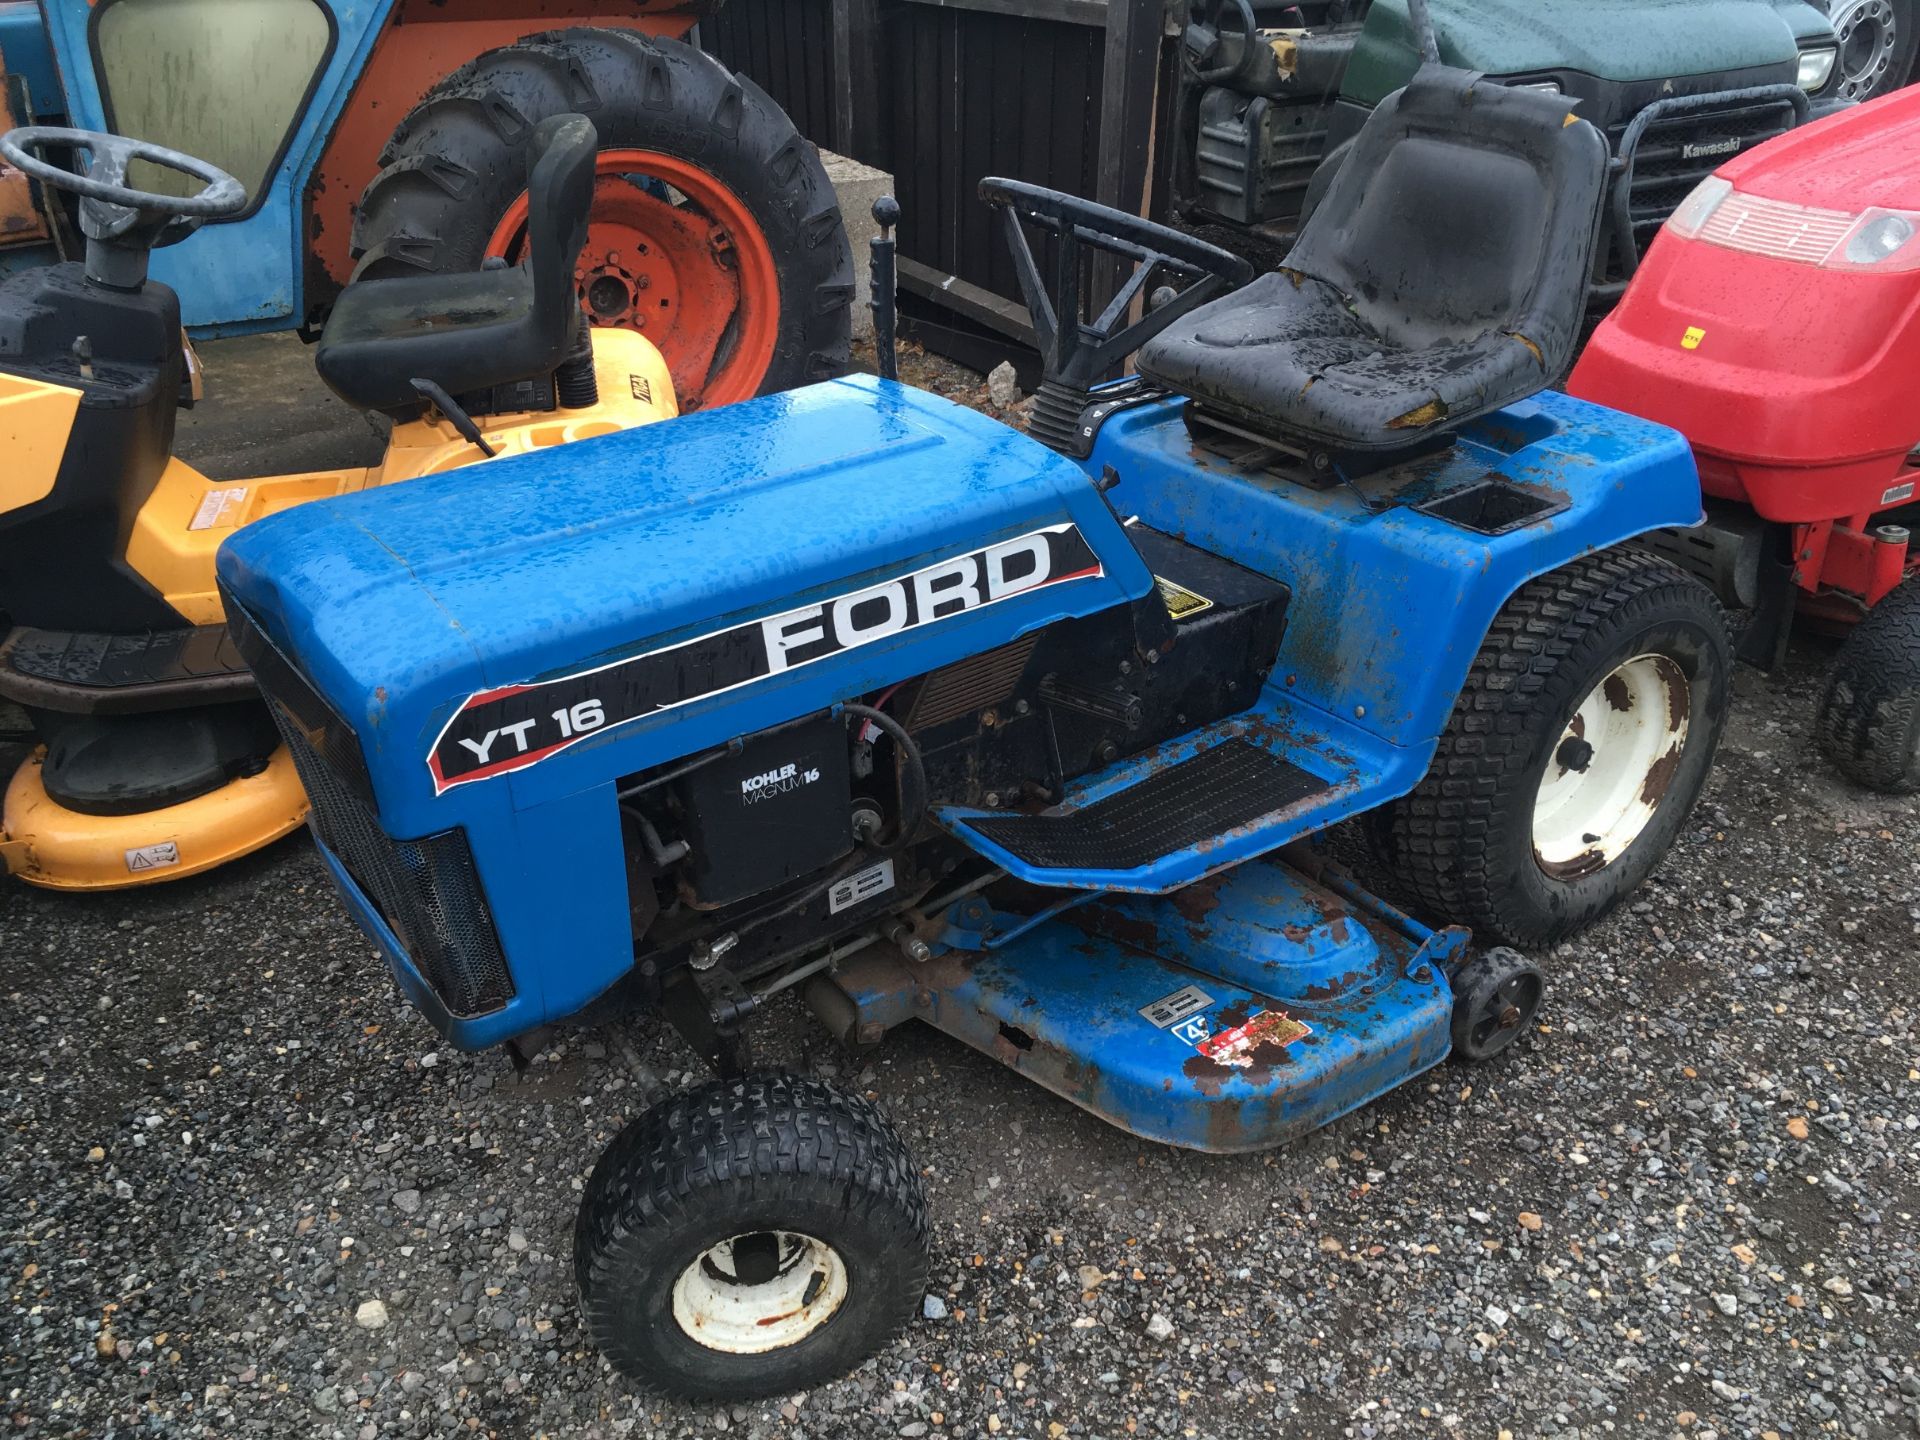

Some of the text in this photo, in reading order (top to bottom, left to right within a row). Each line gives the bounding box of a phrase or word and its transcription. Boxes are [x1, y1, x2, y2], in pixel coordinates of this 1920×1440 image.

[1682, 136, 1741, 159] Kawasaki
[762, 534, 1051, 673] FORD
[457, 699, 606, 764] YT 16
[742, 763, 797, 793] KOHLER
